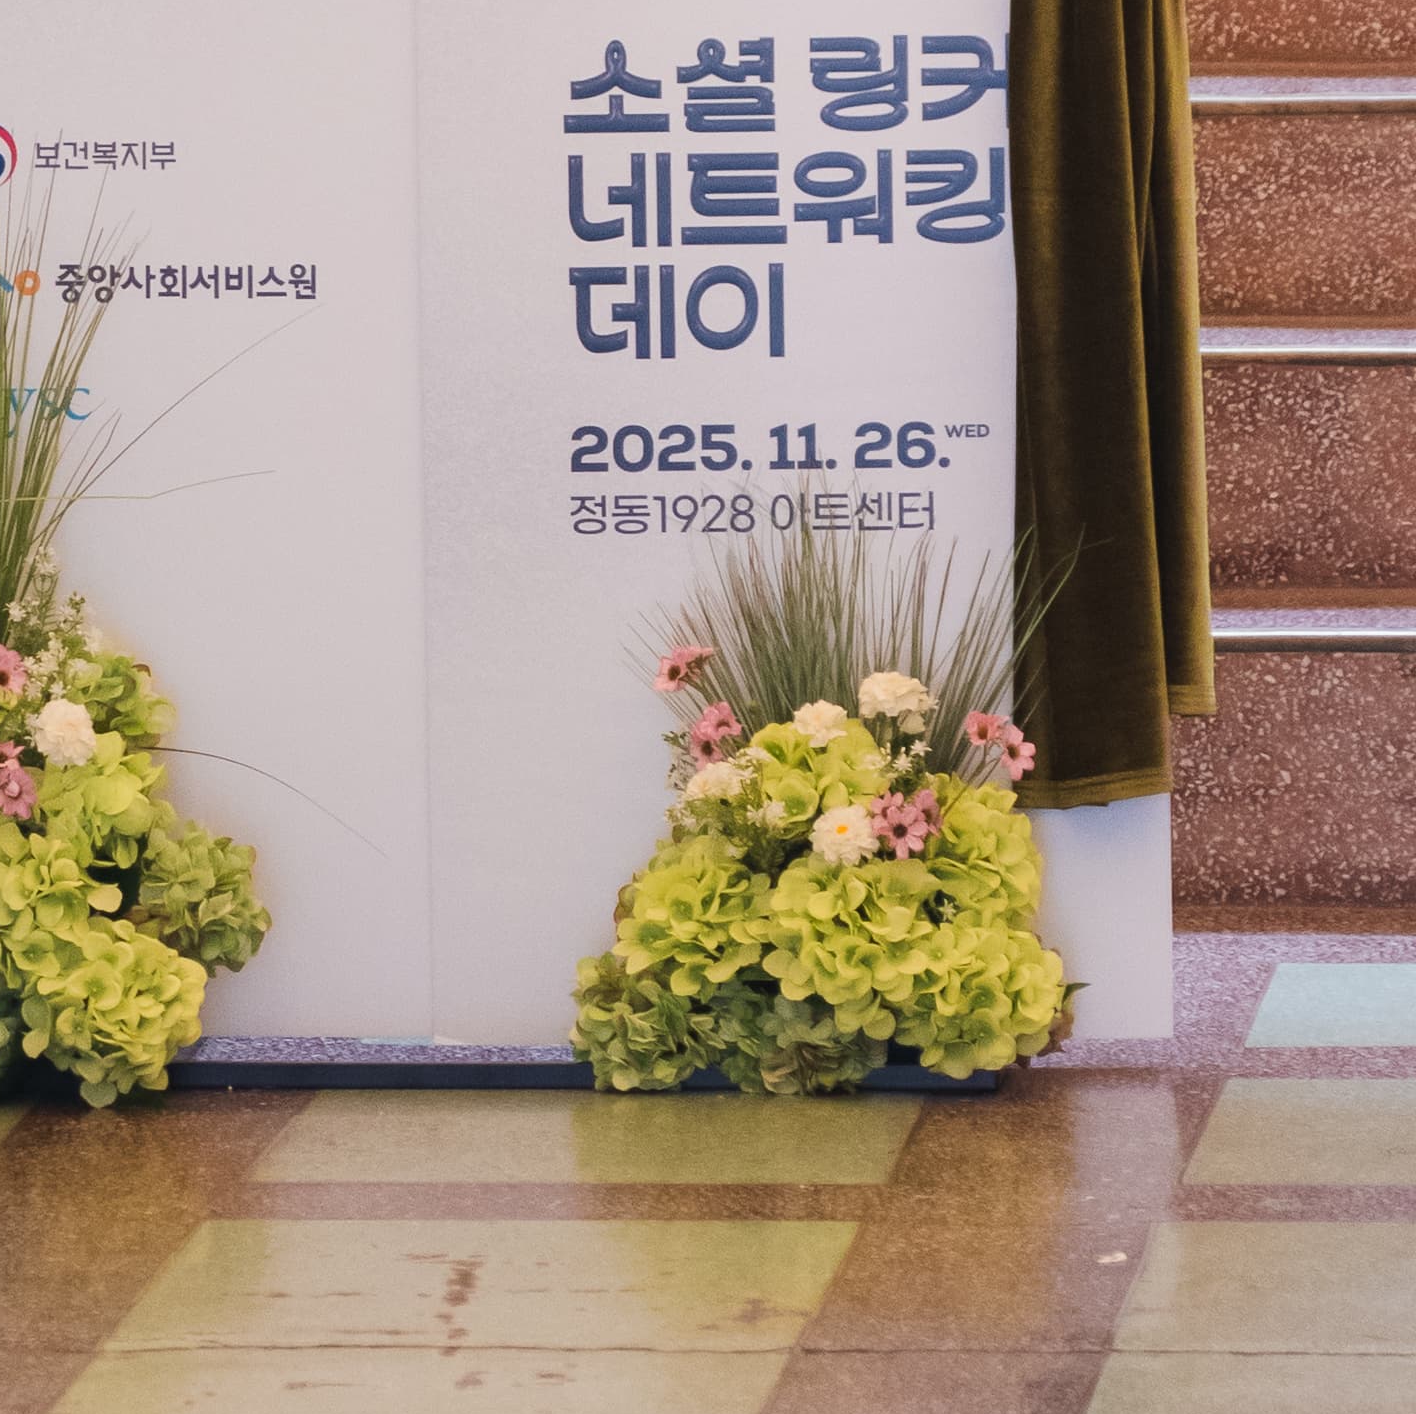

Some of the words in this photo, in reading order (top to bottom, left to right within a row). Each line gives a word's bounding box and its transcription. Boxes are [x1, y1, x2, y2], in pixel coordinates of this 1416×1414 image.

[562, 36, 776, 135] 소셜
[34, 140, 177, 171] 보건복지부
[567, 146, 1006, 248] 네트워킹
[55, 263, 317, 303] 중앙사회서비스원
[568, 262, 786, 360] 데이
[570, 424, 753, 473] 2025.
[768, 422, 838, 471] 11.
[854, 421, 951, 470] 26.
[944, 423, 990, 438] WED
[569, 493, 756, 534] 정동1928
[770, 490, 936, 533] 아트센터
